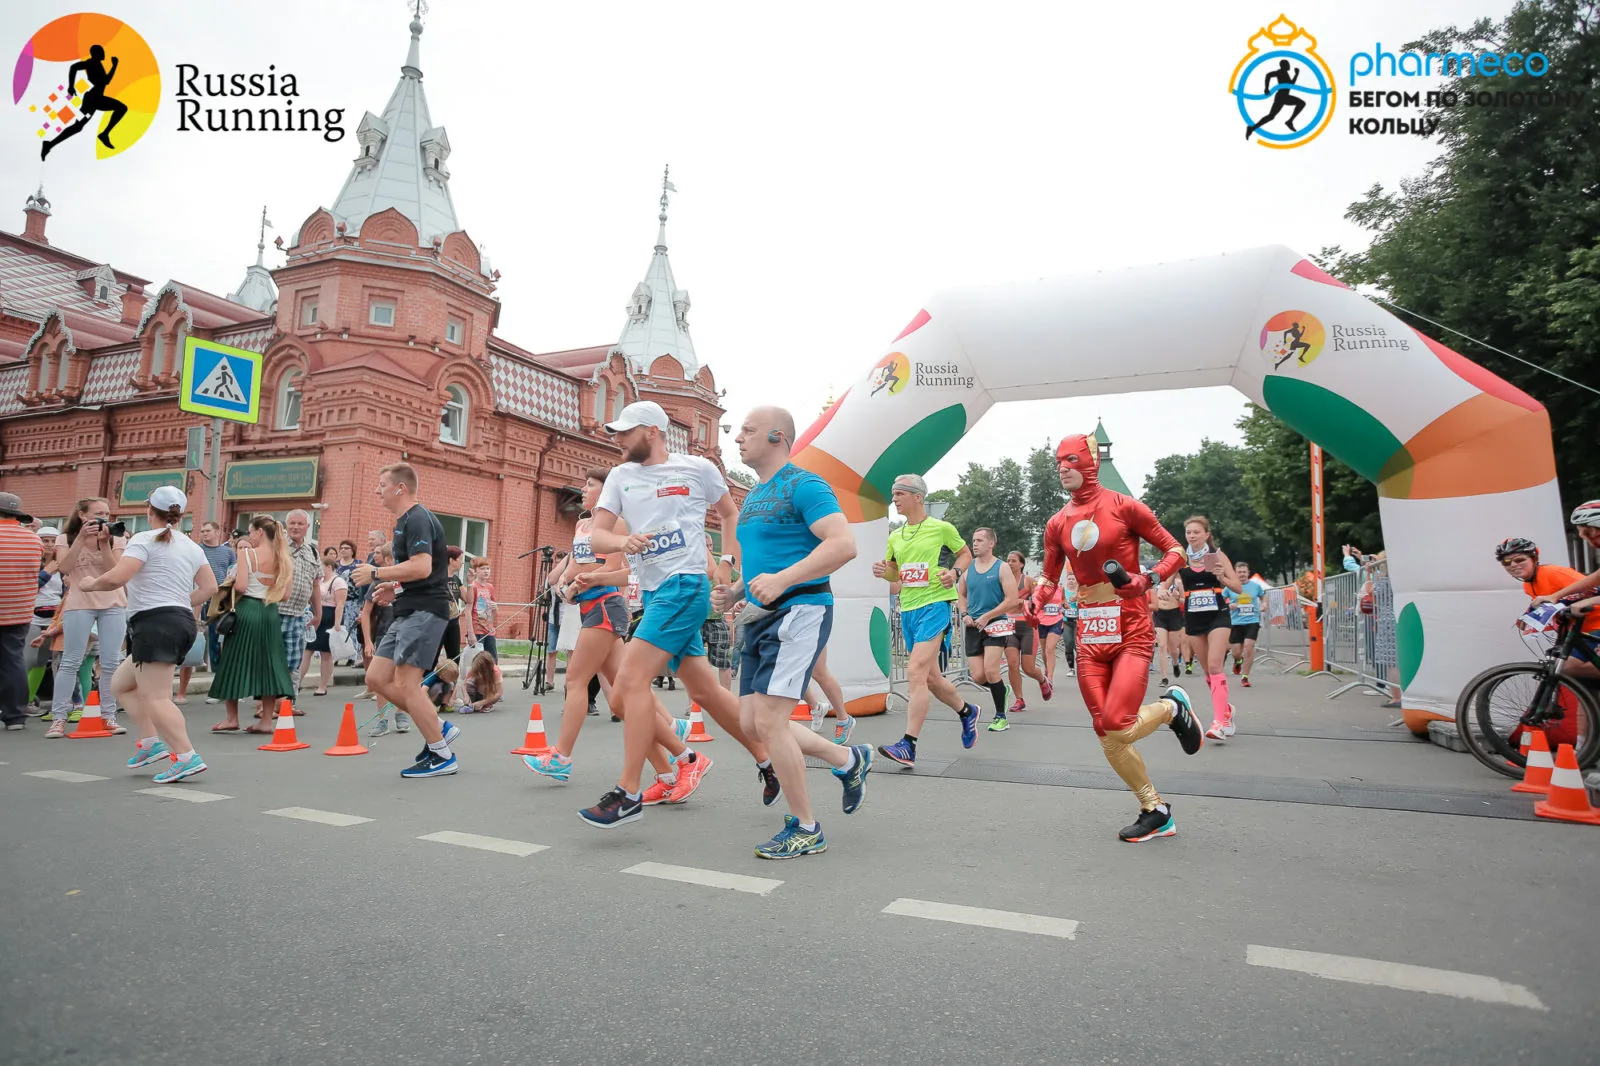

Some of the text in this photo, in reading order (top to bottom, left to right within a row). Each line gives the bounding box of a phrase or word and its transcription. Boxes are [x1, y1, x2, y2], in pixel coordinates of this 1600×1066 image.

[1332, 324, 1387, 338] Russia
[1333, 336, 1410, 352] Running
[915, 362, 959, 375] Russia
[915, 374, 975, 389] Running
[573, 545, 592, 555] 5475
[901, 570, 926, 581] 7247
[1190, 597, 1215, 606] 5693
[1082, 618, 1118, 633] 7498
